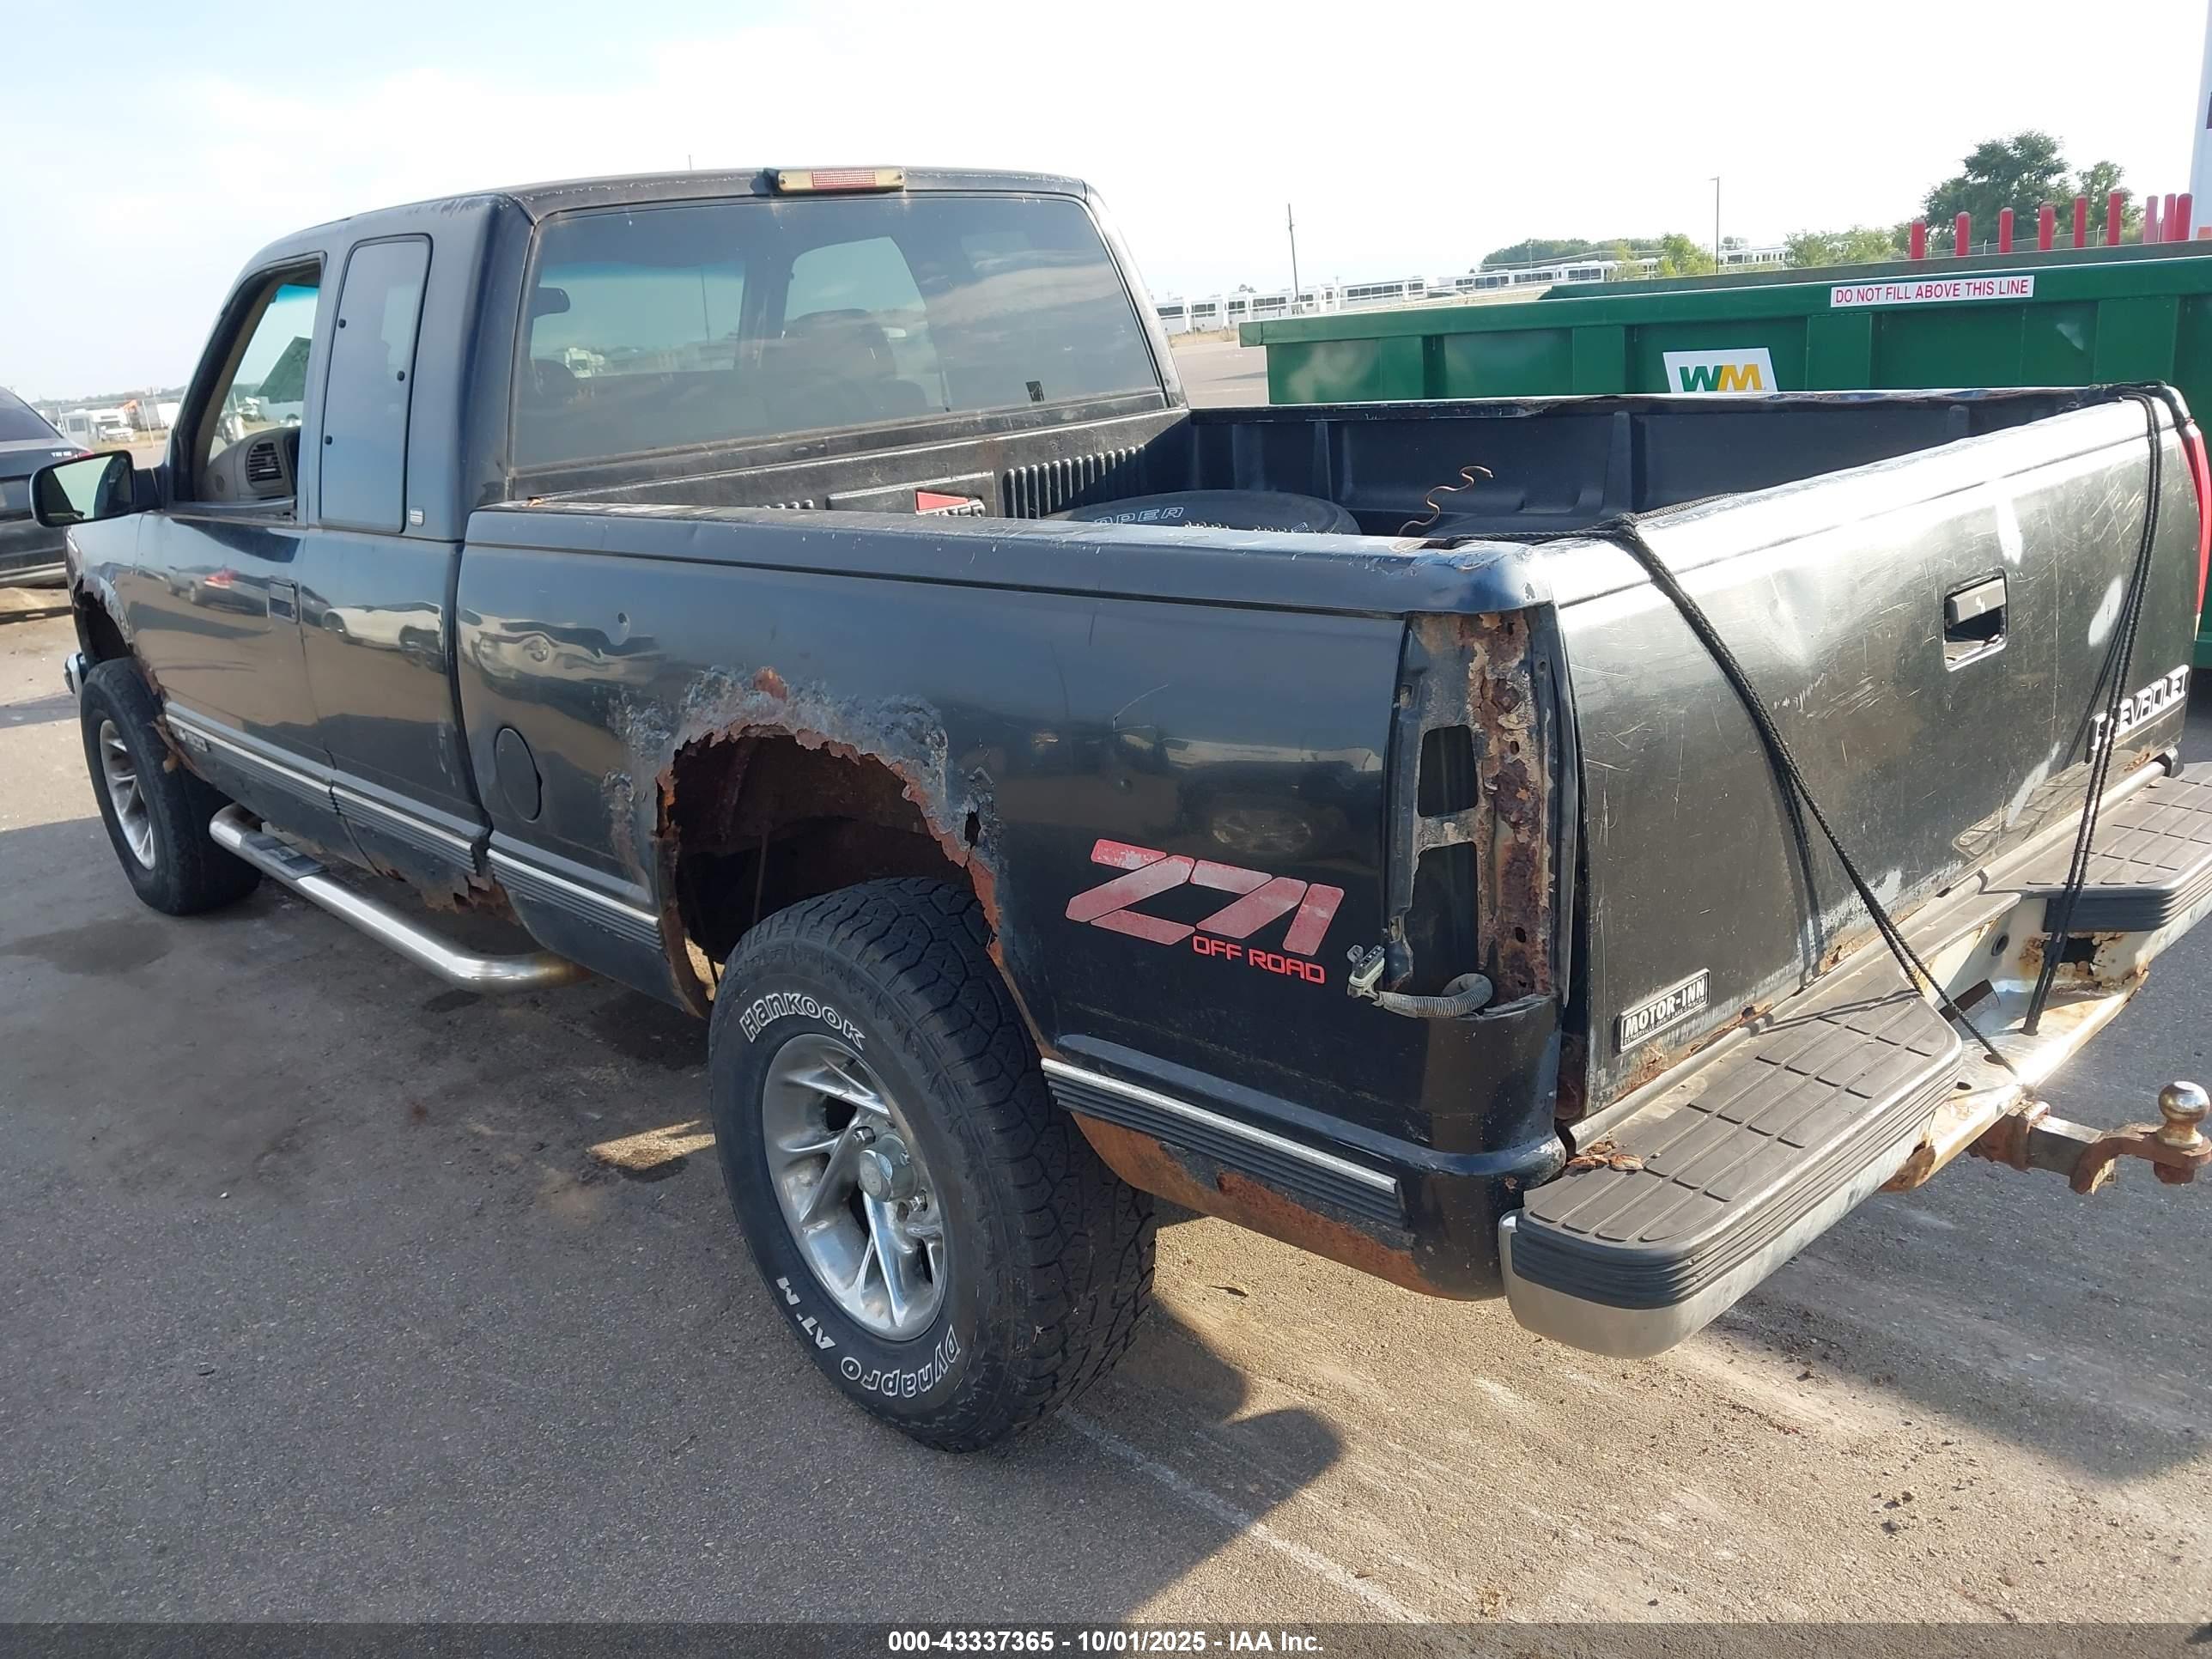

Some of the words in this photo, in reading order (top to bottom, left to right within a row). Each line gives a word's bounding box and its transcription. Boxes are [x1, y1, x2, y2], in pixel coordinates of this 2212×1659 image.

[1835, 289, 1853, 303] DO
[1856, 287, 1881, 302] NOT
[1886, 285, 1911, 301] FILL
[1915, 283, 1961, 299] ABOVE
[1965, 281, 1995, 297] THIS
[1999, 279, 2029, 295] LINE
[1679, 363, 1764, 392] WM
[2090, 664, 2190, 751] EVROLET
[1065, 838, 1345, 957] Z71
[1192, 934, 1243, 961] OFF
[1248, 948, 1326, 984] ROAD
[1625, 977, 1705, 1038] MOTOR-INN
